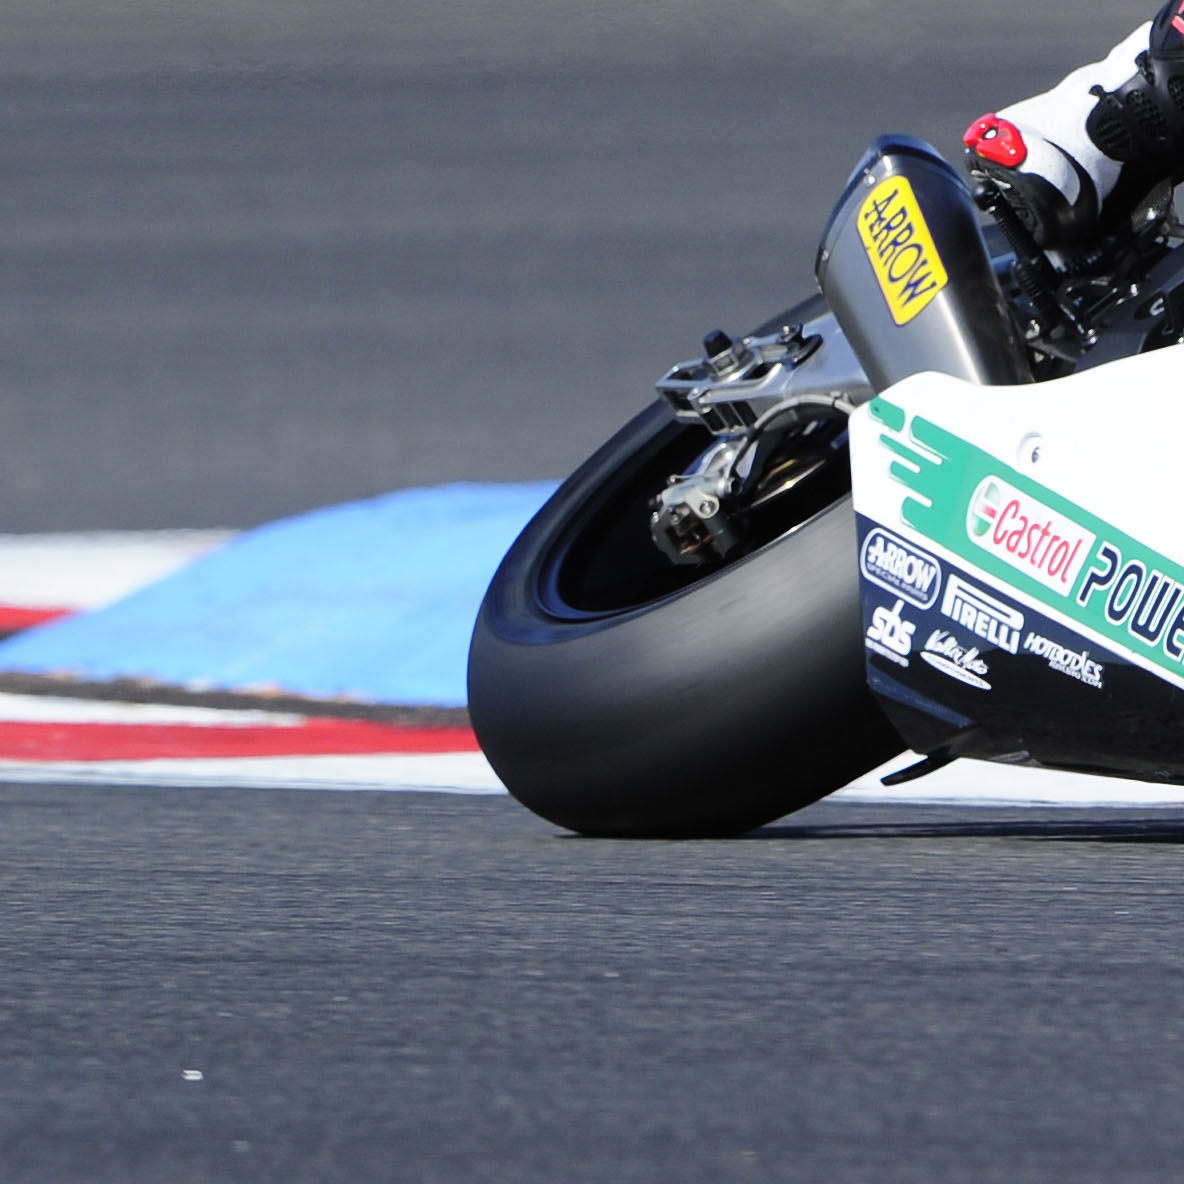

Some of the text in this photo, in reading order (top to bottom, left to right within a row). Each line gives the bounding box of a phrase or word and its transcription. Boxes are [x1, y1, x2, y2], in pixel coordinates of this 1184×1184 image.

[864, 189, 938, 307] ARROW
[867, 537, 937, 592] ARROW
[992, 499, 1082, 584] Castrol
[940, 573, 1025, 655] PIRELLI
[1023, 631, 1103, 681] HOTBODIES
